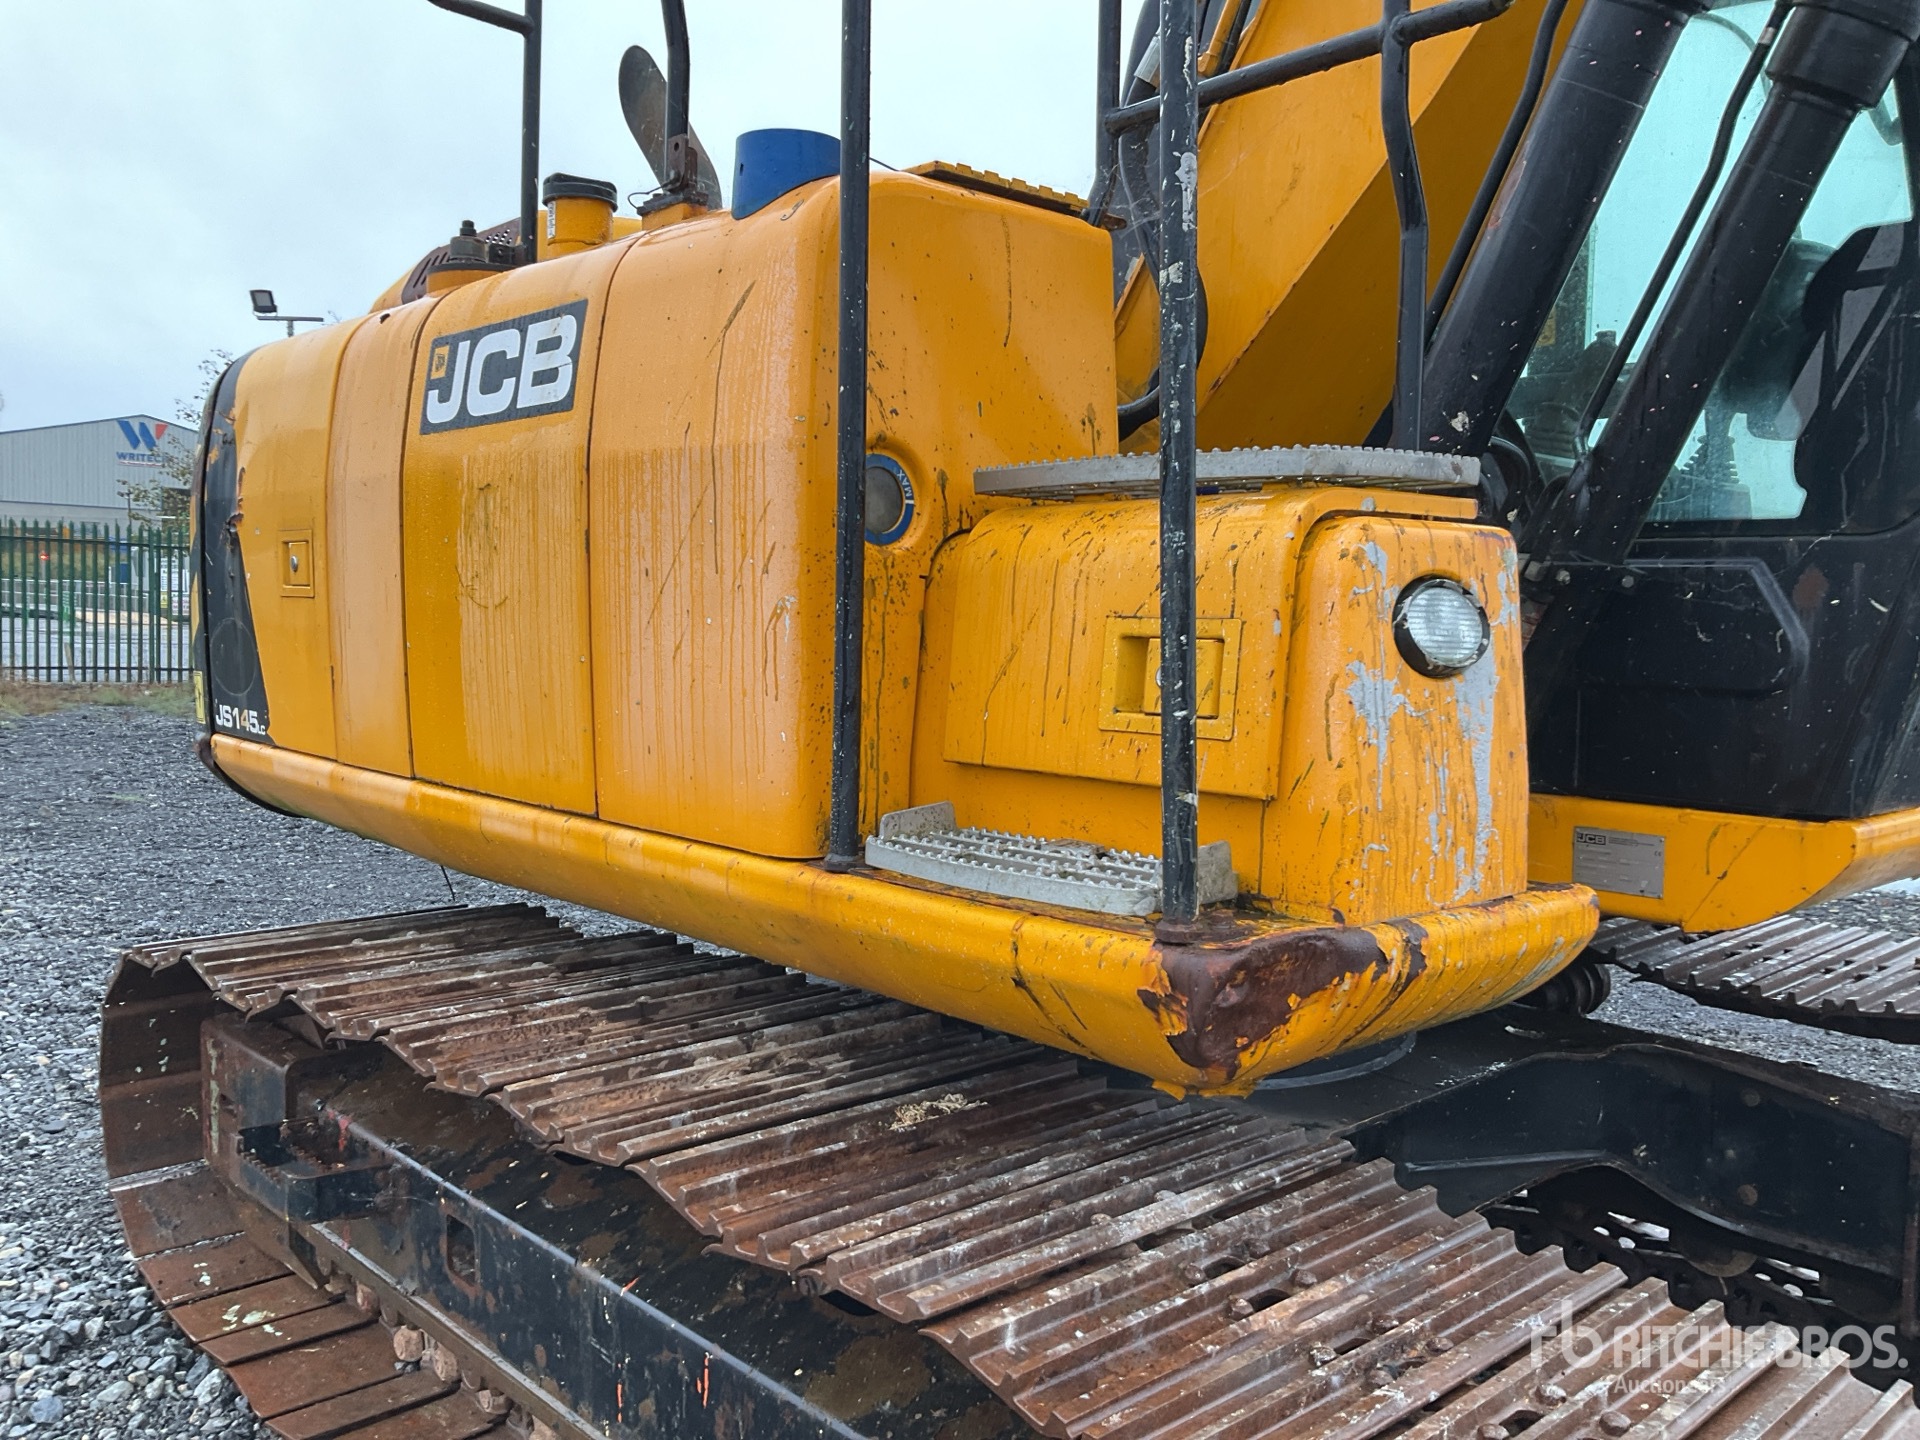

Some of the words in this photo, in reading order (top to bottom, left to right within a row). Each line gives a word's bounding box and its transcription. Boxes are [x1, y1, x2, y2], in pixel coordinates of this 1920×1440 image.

[426, 314, 577, 424] JCB
[897, 469, 912, 497] MAX
[1576, 833, 1606, 845] JCB
